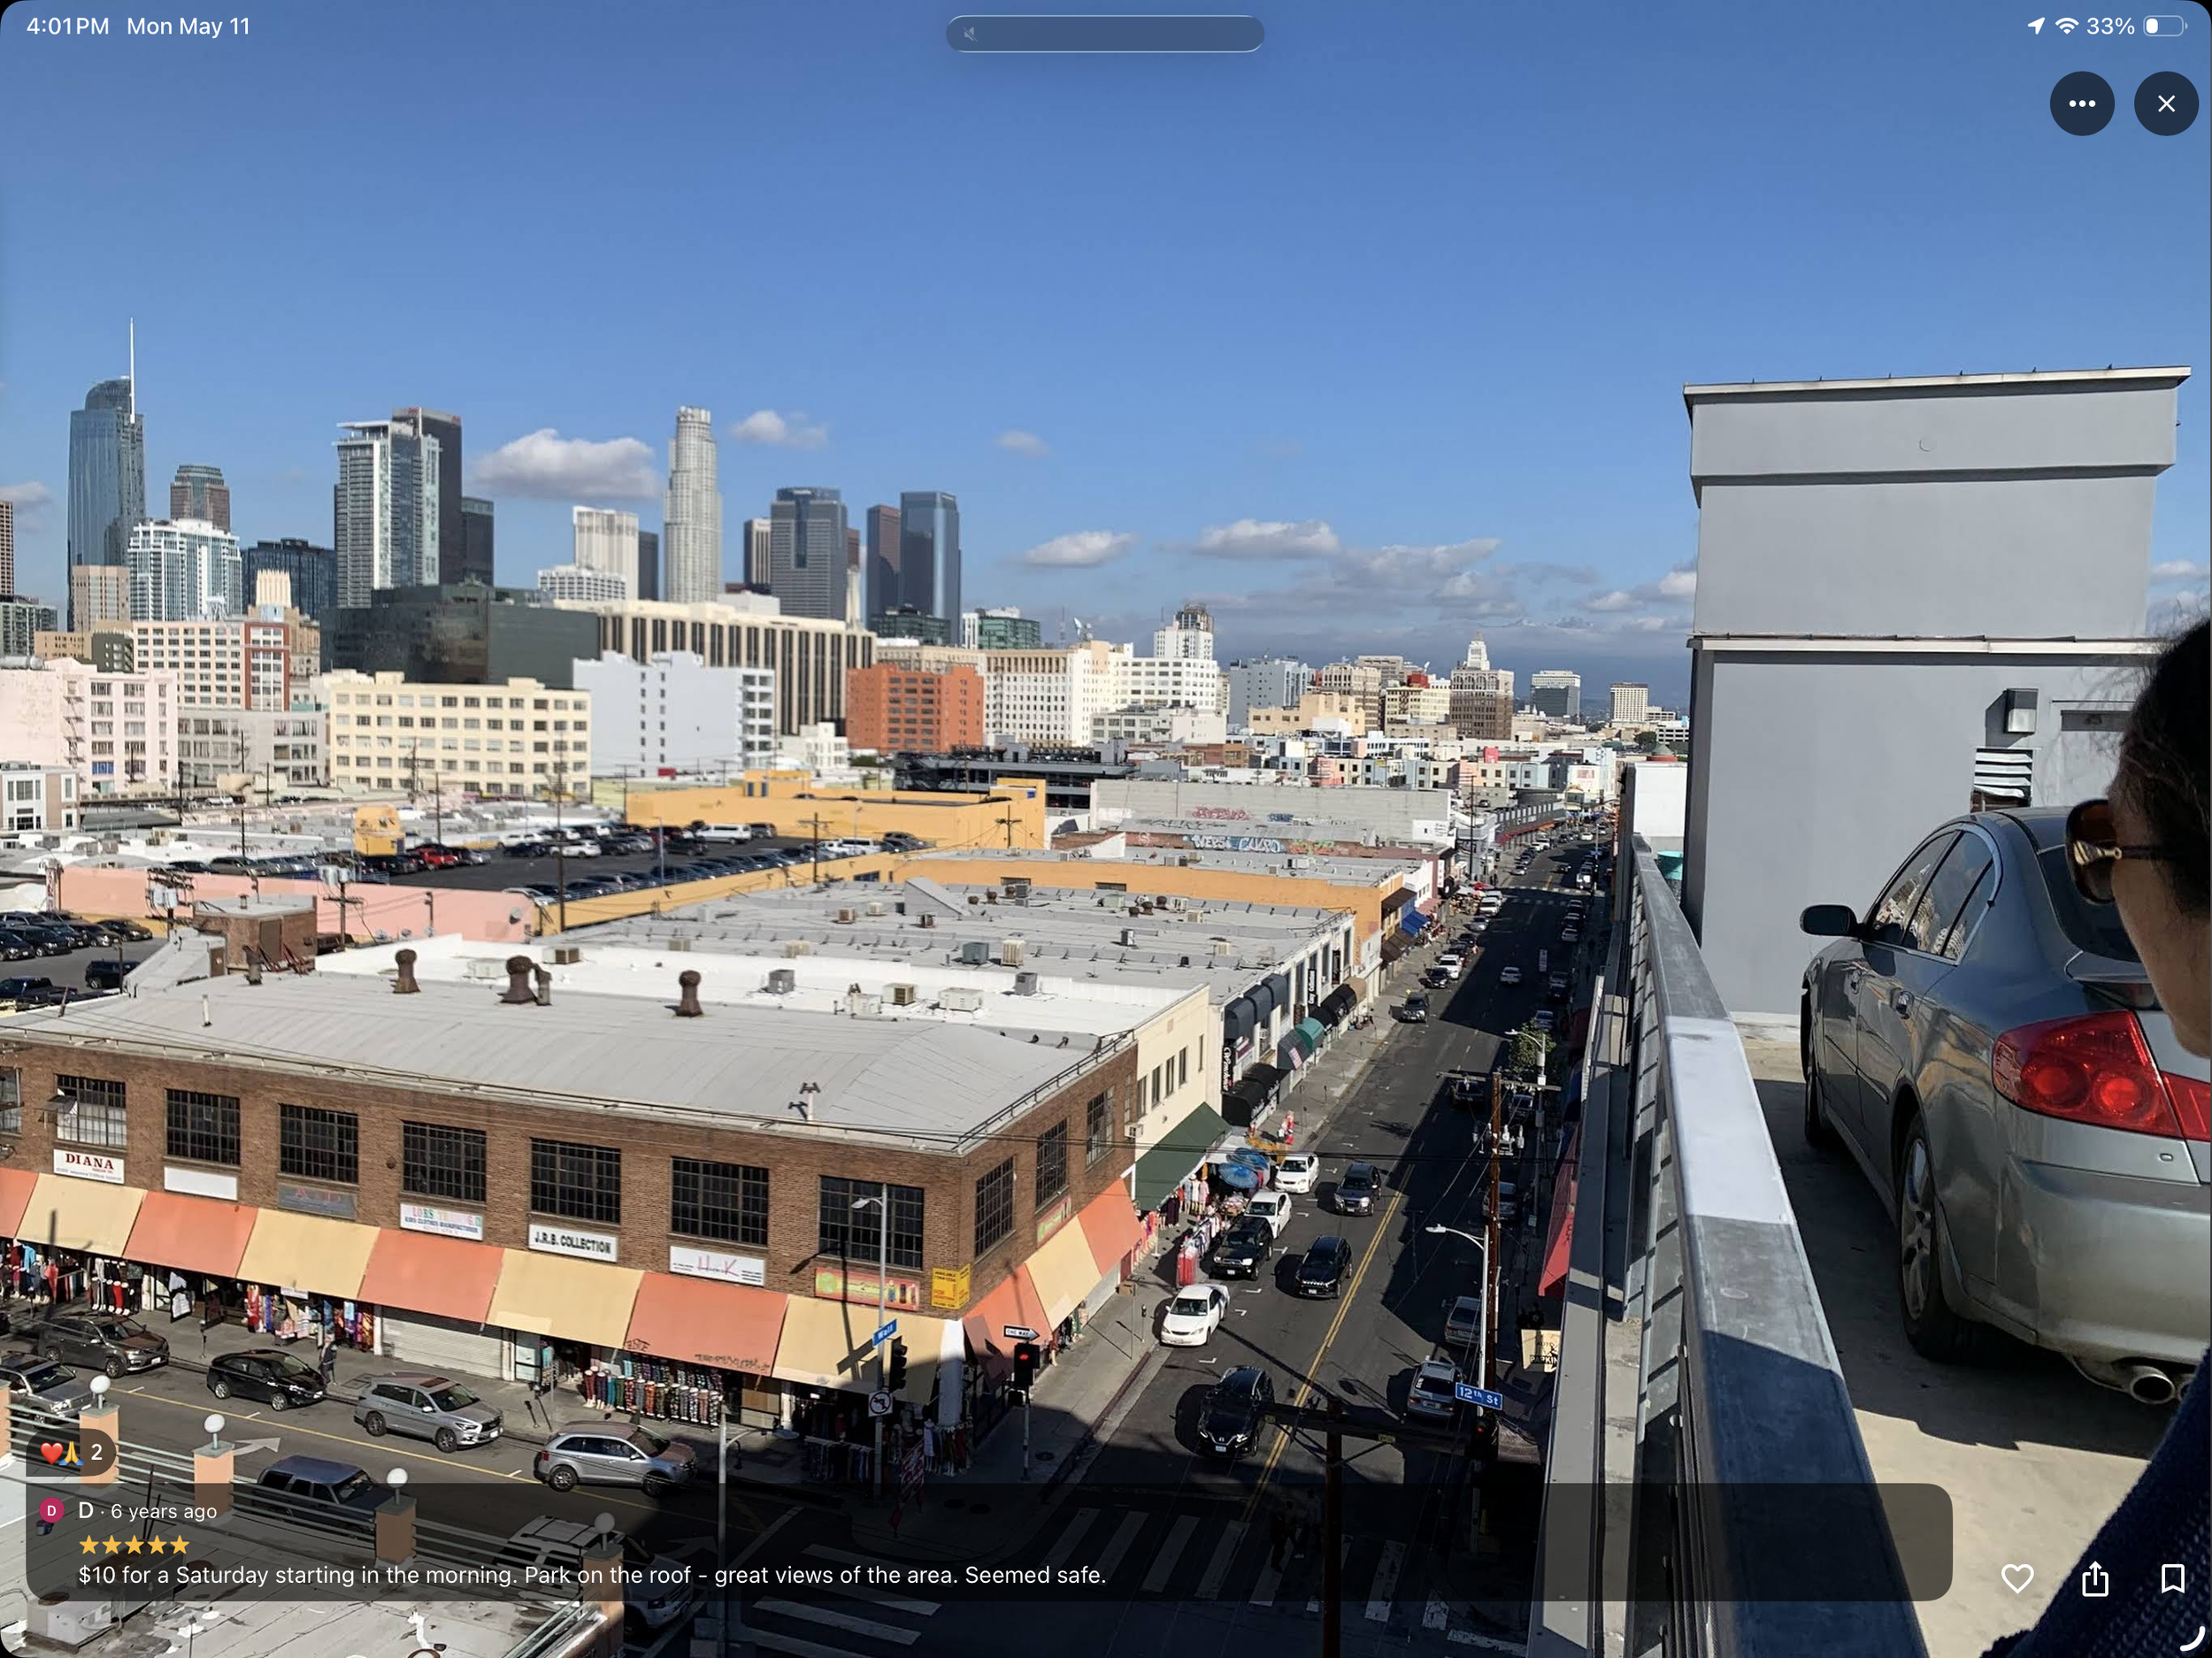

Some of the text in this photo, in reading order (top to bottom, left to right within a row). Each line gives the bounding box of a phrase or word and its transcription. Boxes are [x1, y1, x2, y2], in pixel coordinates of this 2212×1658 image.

[65, 1153, 114, 1170] DIANA
[534, 1232, 611, 1254] J.R.B. COLLECTION
[1530, 1355, 1558, 1364] PARKIN
[1460, 1386, 1498, 1406] 12th St
